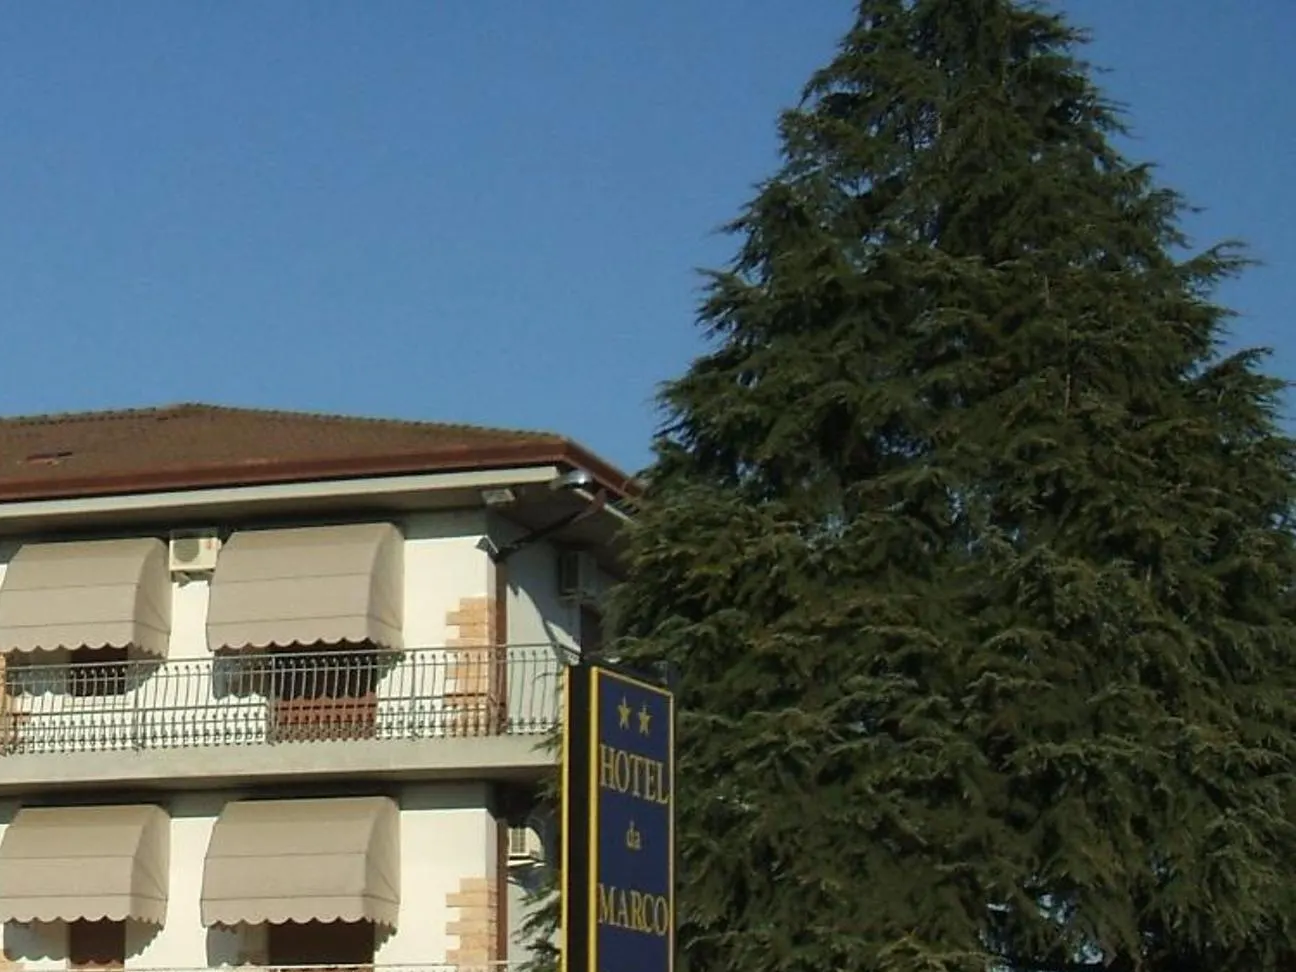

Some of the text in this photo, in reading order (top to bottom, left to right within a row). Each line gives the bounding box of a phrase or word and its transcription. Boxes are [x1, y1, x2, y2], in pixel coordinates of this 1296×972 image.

[599, 743, 668, 804] HOTEL
[627, 821, 641, 849] da
[599, 883, 668, 936] MARCO
